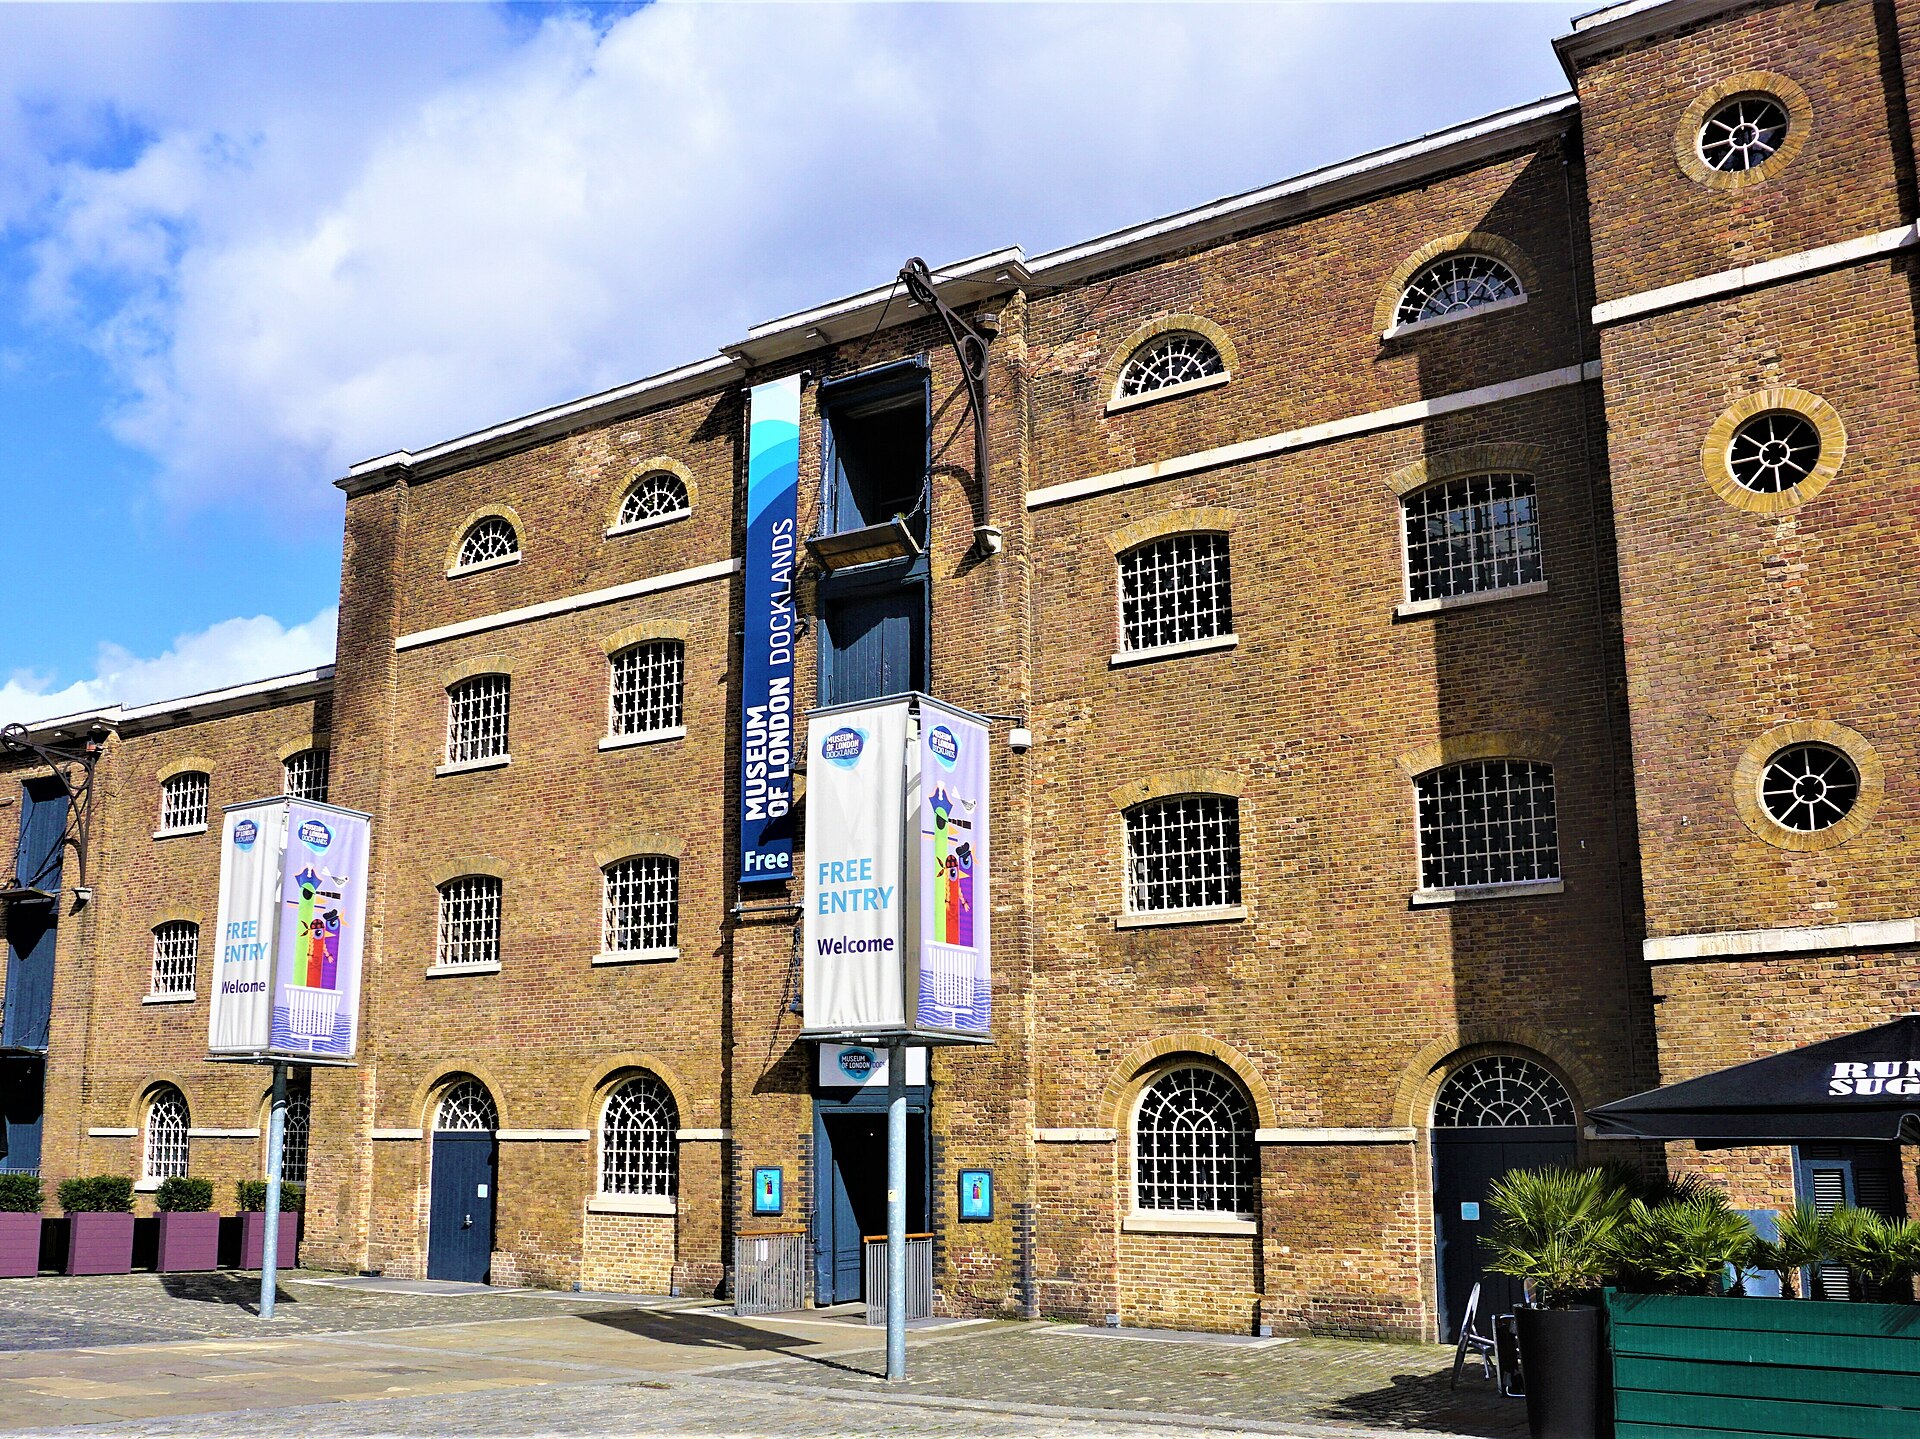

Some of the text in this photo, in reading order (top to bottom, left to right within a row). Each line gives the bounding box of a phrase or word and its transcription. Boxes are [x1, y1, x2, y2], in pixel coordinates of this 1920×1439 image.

[767, 517, 793, 818] OF LONDON DOCKLANDS
[826, 733, 854, 744] MUSEUM
[932, 730, 952, 743] MUSEUM
[826, 739, 859, 752] OF LONDON
[932, 744, 956, 759] DOCKLANDS
[938, 739, 956, 752] LONDON
[826, 748, 859, 759] DOCKLANDS
[745, 704, 768, 821] MUSEUM
[240, 829, 255, 837] LONDON
[303, 823, 324, 833] MUSEUM
[301, 835, 328, 846] DOCKLANDS
[309, 830, 328, 840] LONDON
[744, 850, 789, 872] Free
[819, 858, 872, 885] FREE
[819, 886, 894, 915] ENTRY
[226, 920, 257, 940] FREE
[817, 935, 894, 956] Welcome
[224, 942, 268, 963] ENTRY
[221, 979, 266, 994] Welcome
[841, 1055, 865, 1063] MUSEUM
[849, 1061, 870, 1069] LONDON
